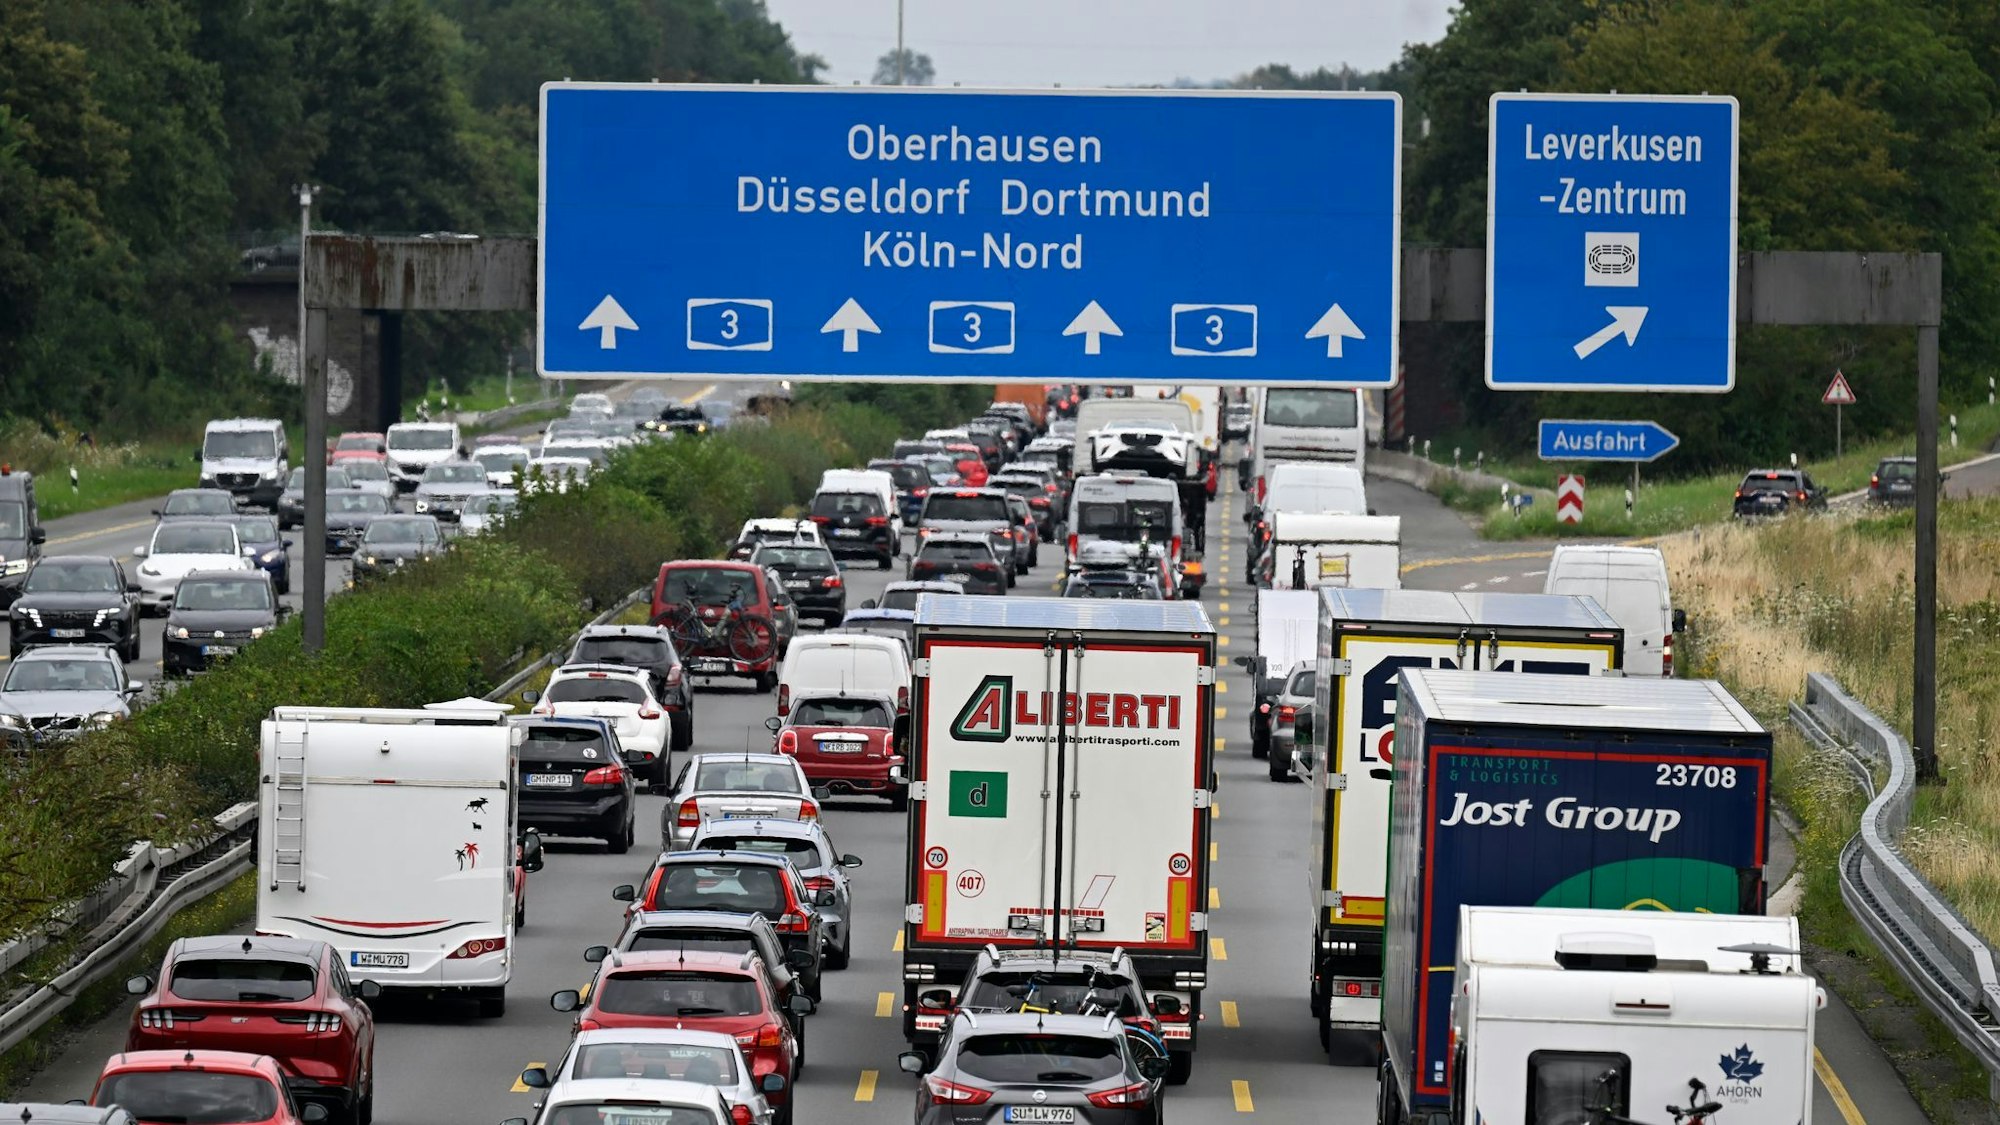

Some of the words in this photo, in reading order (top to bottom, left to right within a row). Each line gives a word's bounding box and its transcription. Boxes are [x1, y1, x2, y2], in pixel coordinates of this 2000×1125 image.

[848, 124, 1101, 163] Oberhausen
[1525, 124, 1702, 162] Leverkusen
[737, 176, 970, 214] Düsseldorf
[1001, 179, 1210, 218] Dortmund
[1540, 178, 1686, 215] -Zentrum
[863, 231, 1082, 270] Köln-Nord
[720, 309, 738, 340] 3
[963, 312, 982, 343] 3
[1204, 315, 1224, 346] 3
[1554, 430, 1646, 452] Ausfahrt
[1449, 756, 1552, 770] TRANSPORT
[1656, 763, 1737, 789] 23708
[1449, 770, 1459, 781] &
[1471, 771, 1559, 785] LOGISTICS
[969, 781, 989, 807] d
[1440, 792, 1533, 828] Jost
[1545, 797, 1682, 844] Group
[930, 853, 944, 863] 70
[1173, 859, 1187, 869] 80
[959, 876, 982, 890] 407
[361, 954, 368, 965] W
[373, 954, 386, 965] MU
[387, 954, 404, 966] 778
[1716, 1085, 1763, 1098] AHORN
[1012, 1107, 1026, 1119] SU
[1034, 1108, 1049, 1120] LW
[1051, 1108, 1073, 1120] 976
